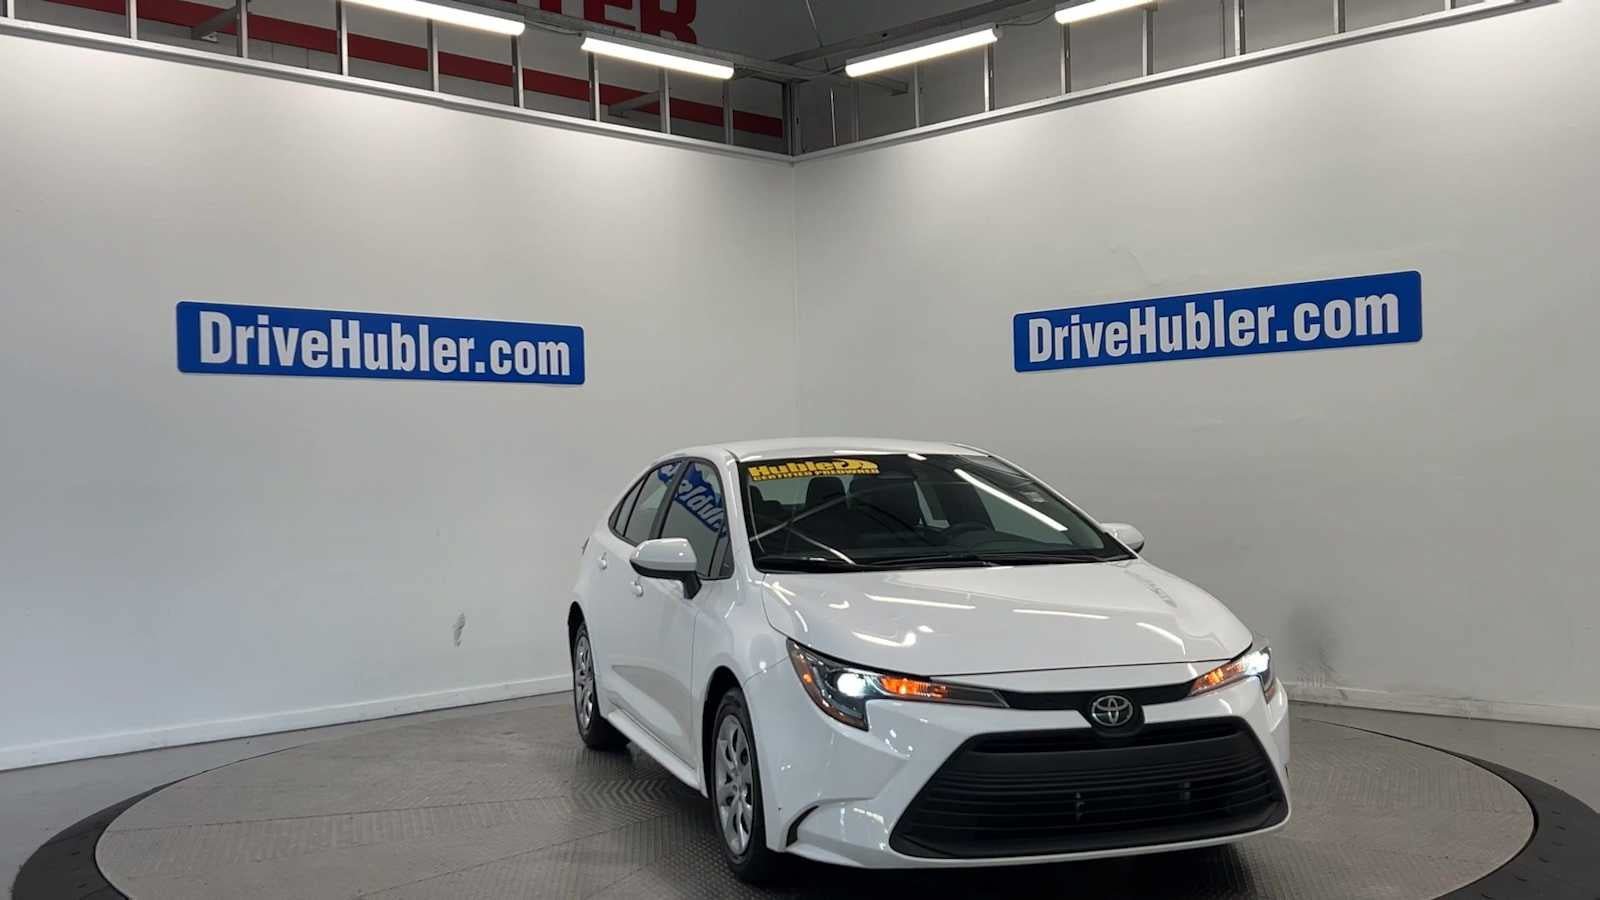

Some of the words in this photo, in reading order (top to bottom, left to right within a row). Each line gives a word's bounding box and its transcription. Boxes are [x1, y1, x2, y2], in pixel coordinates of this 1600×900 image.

[201, 312, 570, 376] DriveHubler.com
[1030, 294, 1398, 362] DriveHubler.com
[748, 460, 850, 476] Hubler
